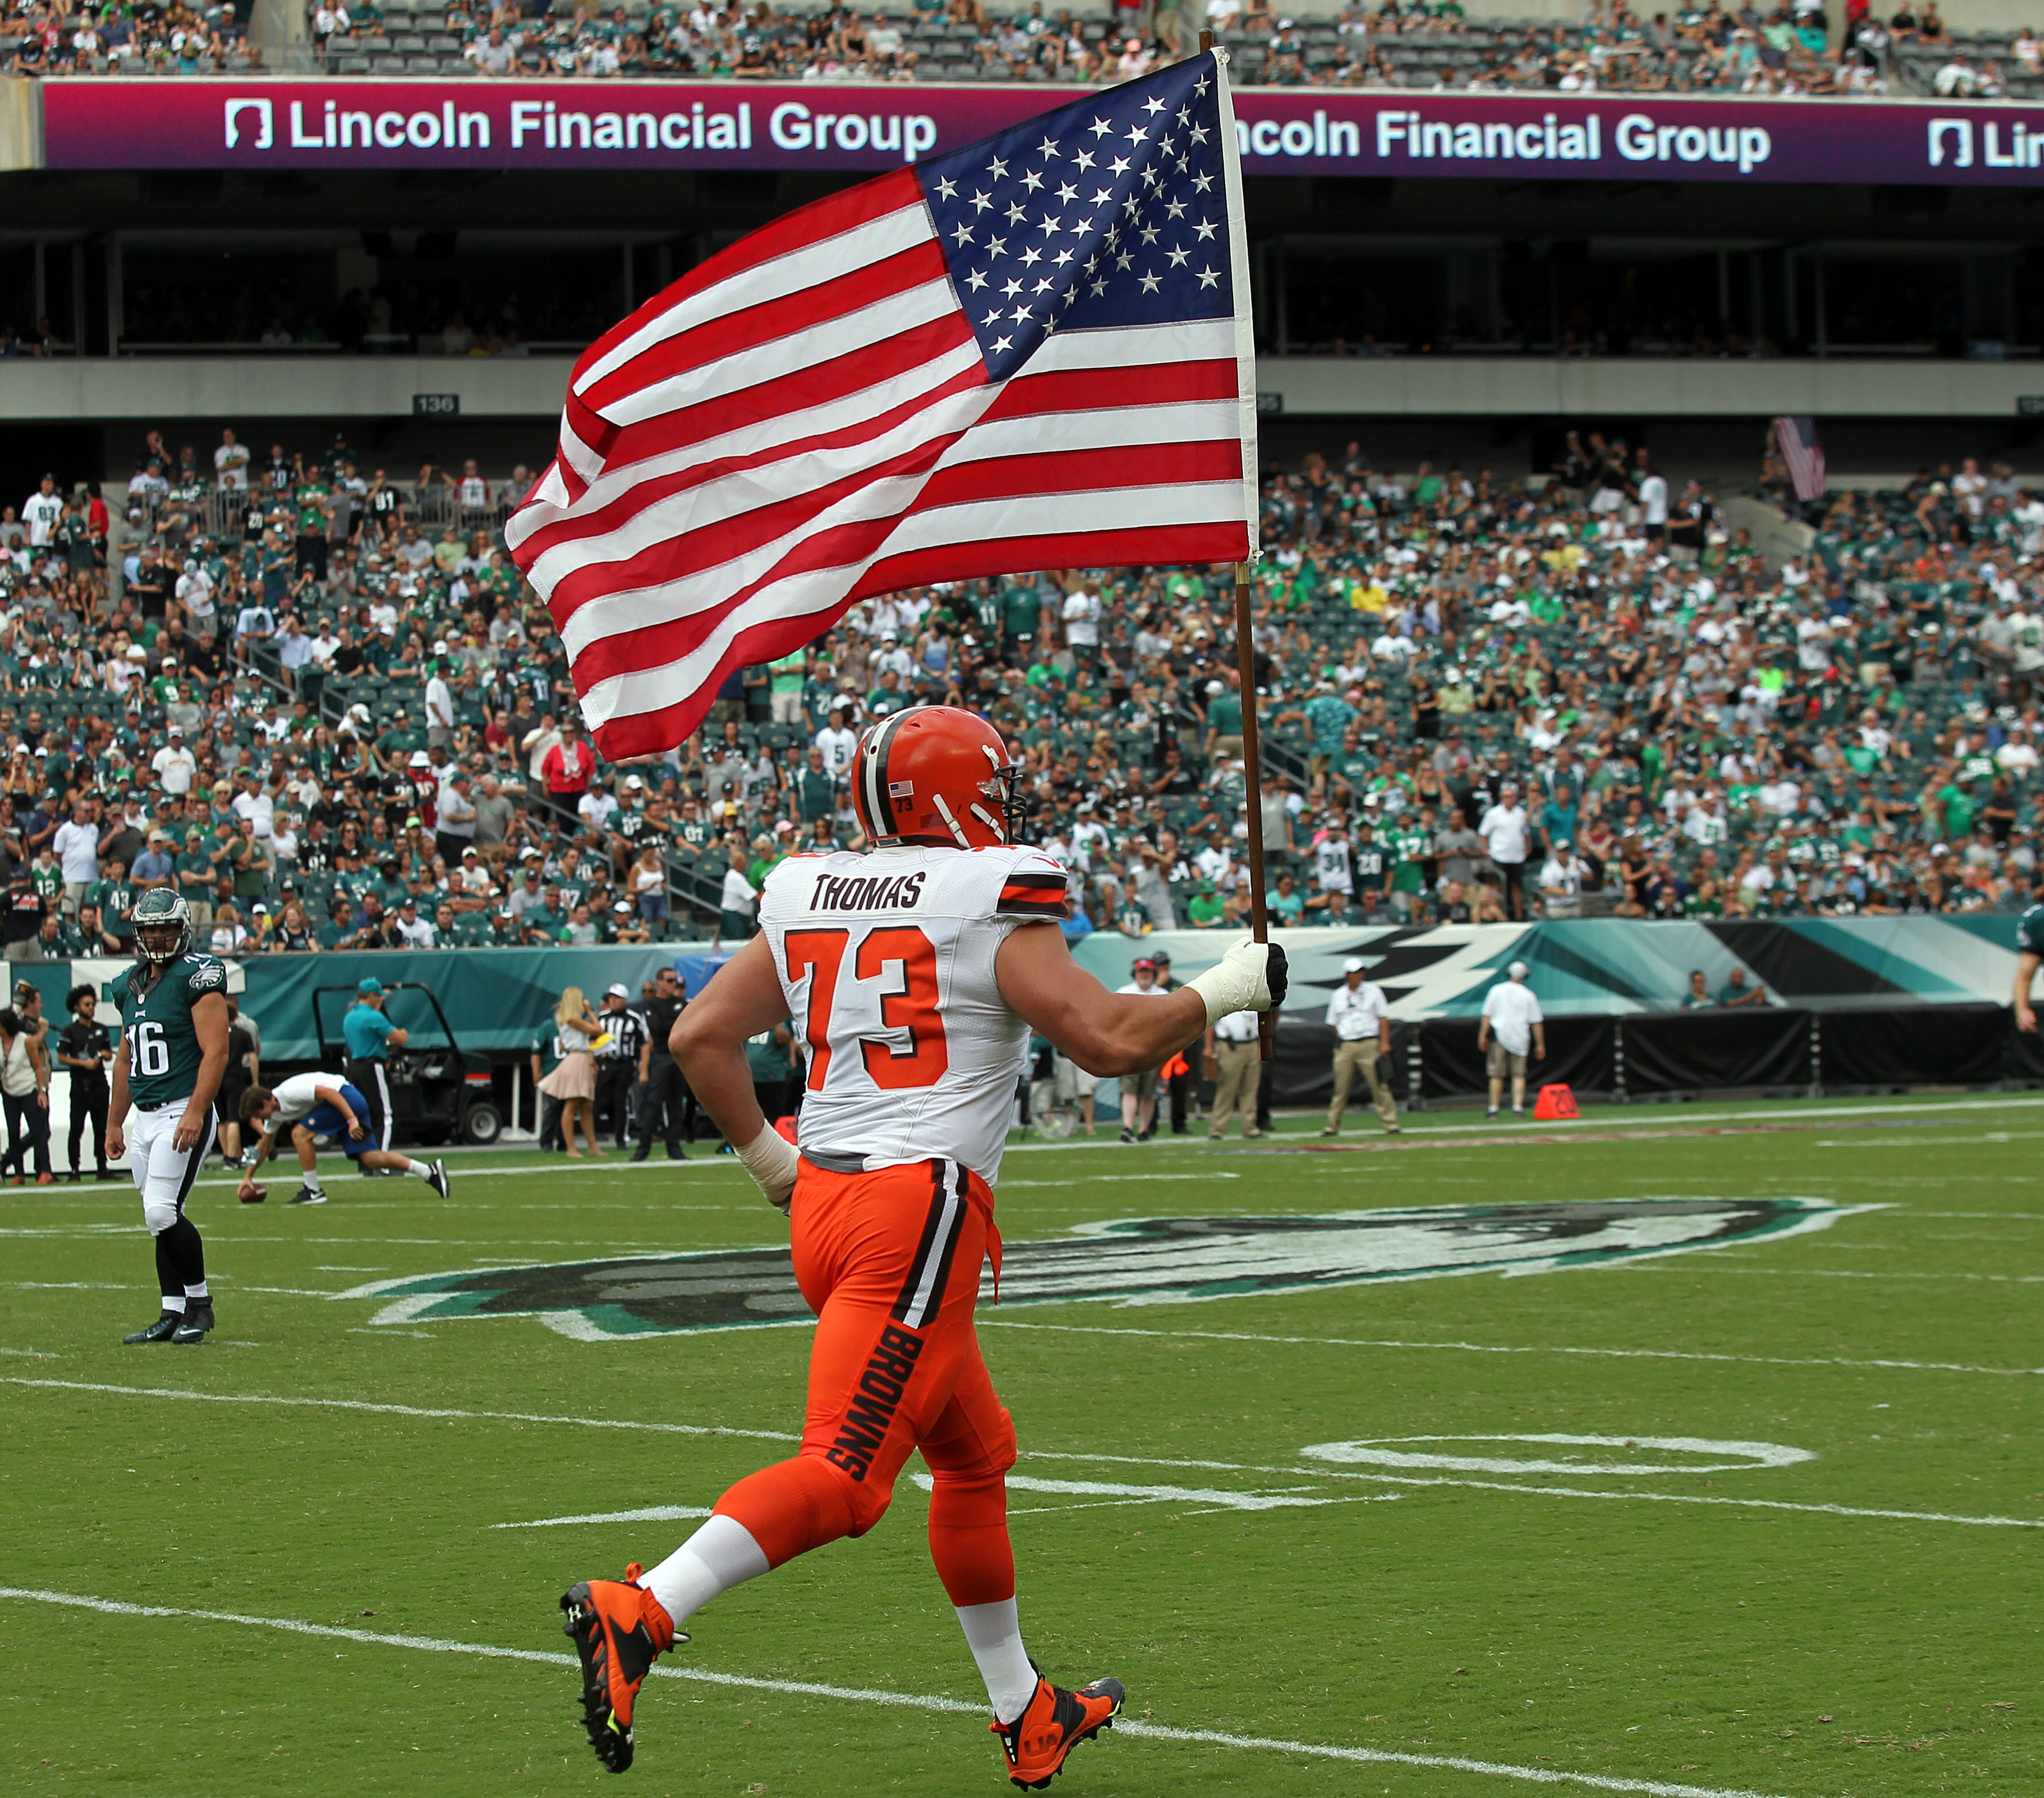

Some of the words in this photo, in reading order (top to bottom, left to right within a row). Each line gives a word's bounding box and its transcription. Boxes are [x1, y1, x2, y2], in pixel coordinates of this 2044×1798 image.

[290, 99, 490, 149] Lincoln
[510, 101, 752, 151] Financial
[769, 101, 937, 163] Group
[1376, 110, 1601, 160] Financial
[1615, 113, 1772, 174] Group
[418, 397, 454, 413] 136
[375, 491, 394, 511] 91
[836, 745, 848, 764] 5
[894, 797, 914, 813] 73
[37, 878, 56, 897] 12
[809, 871, 926, 912] THOMAS
[783, 924, 950, 1091] 73
[825, 1324, 925, 1482] BROWNS
